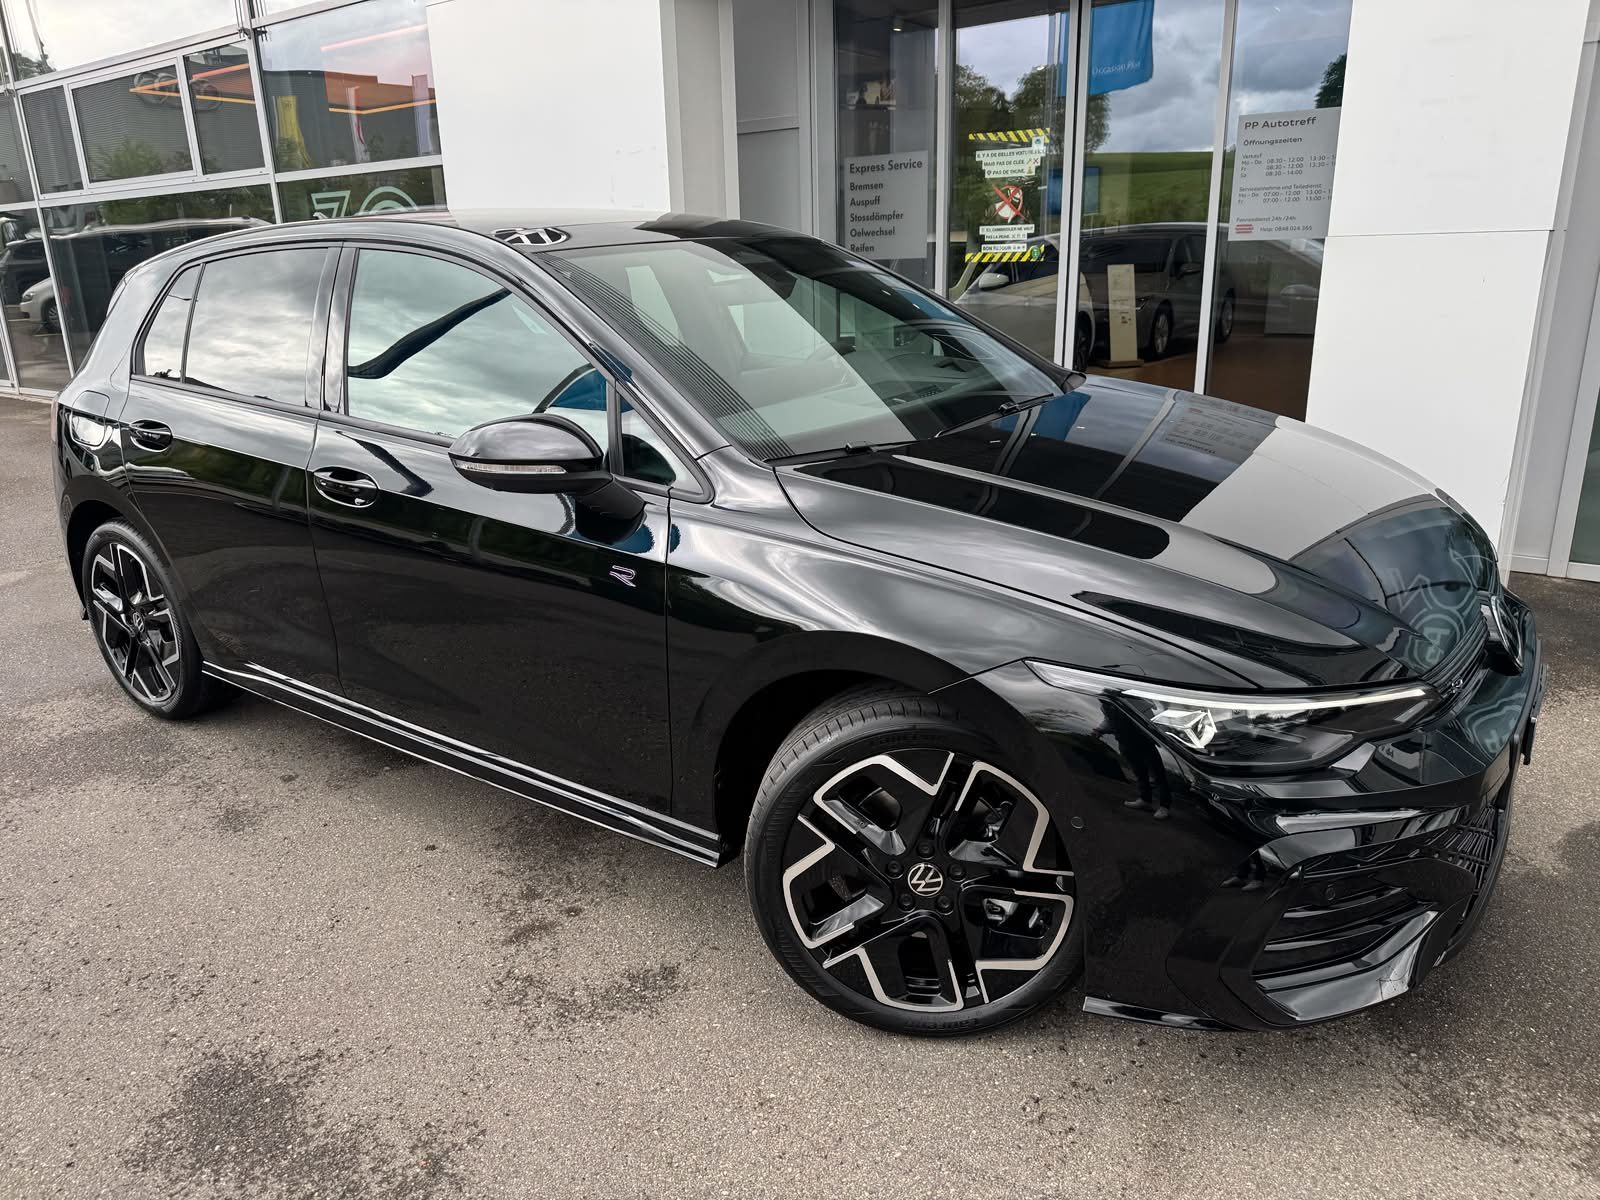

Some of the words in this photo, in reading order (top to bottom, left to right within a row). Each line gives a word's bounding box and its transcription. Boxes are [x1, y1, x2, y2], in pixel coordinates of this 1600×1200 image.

[1244, 121, 1259, 130] PP
[1261, 116, 1316, 128] Autotreff
[1243, 136, 1302, 146] Öffnungszeiten
[849, 163, 885, 176] Express
[888, 159, 922, 170] Service
[850, 182, 884, 191] Bremsen
[850, 196, 880, 207] Auspuff
[850, 210, 904, 222] Stossdämpfer
[850, 226, 896, 238] Oelwechsel
[850, 243, 874, 252] Reifen
